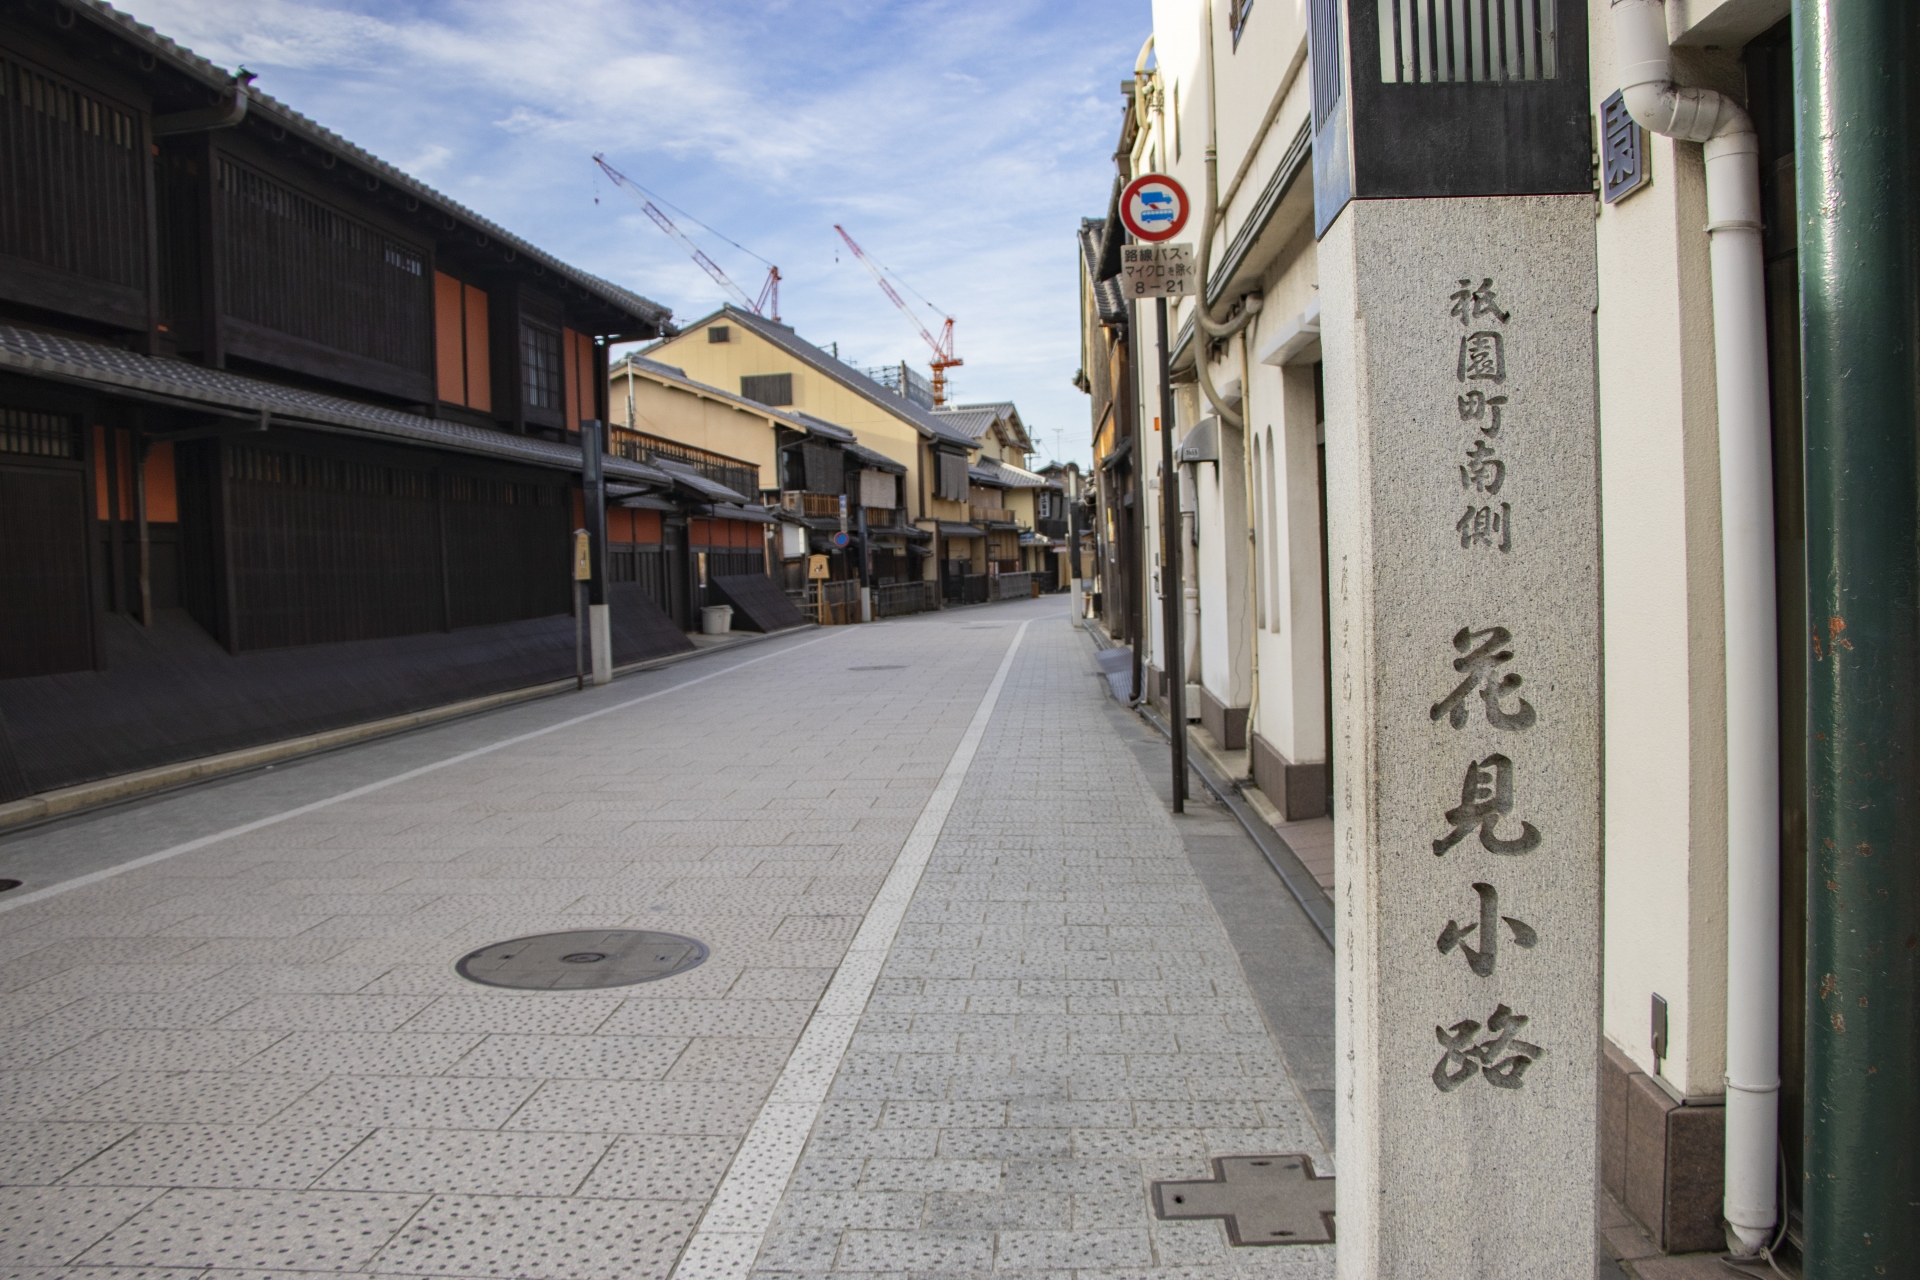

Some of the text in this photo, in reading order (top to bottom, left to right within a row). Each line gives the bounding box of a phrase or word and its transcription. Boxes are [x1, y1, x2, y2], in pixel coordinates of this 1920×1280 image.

[1450, 277, 1512, 554] 祇園町南側
[1429, 626, 1546, 1093] 花見小路
